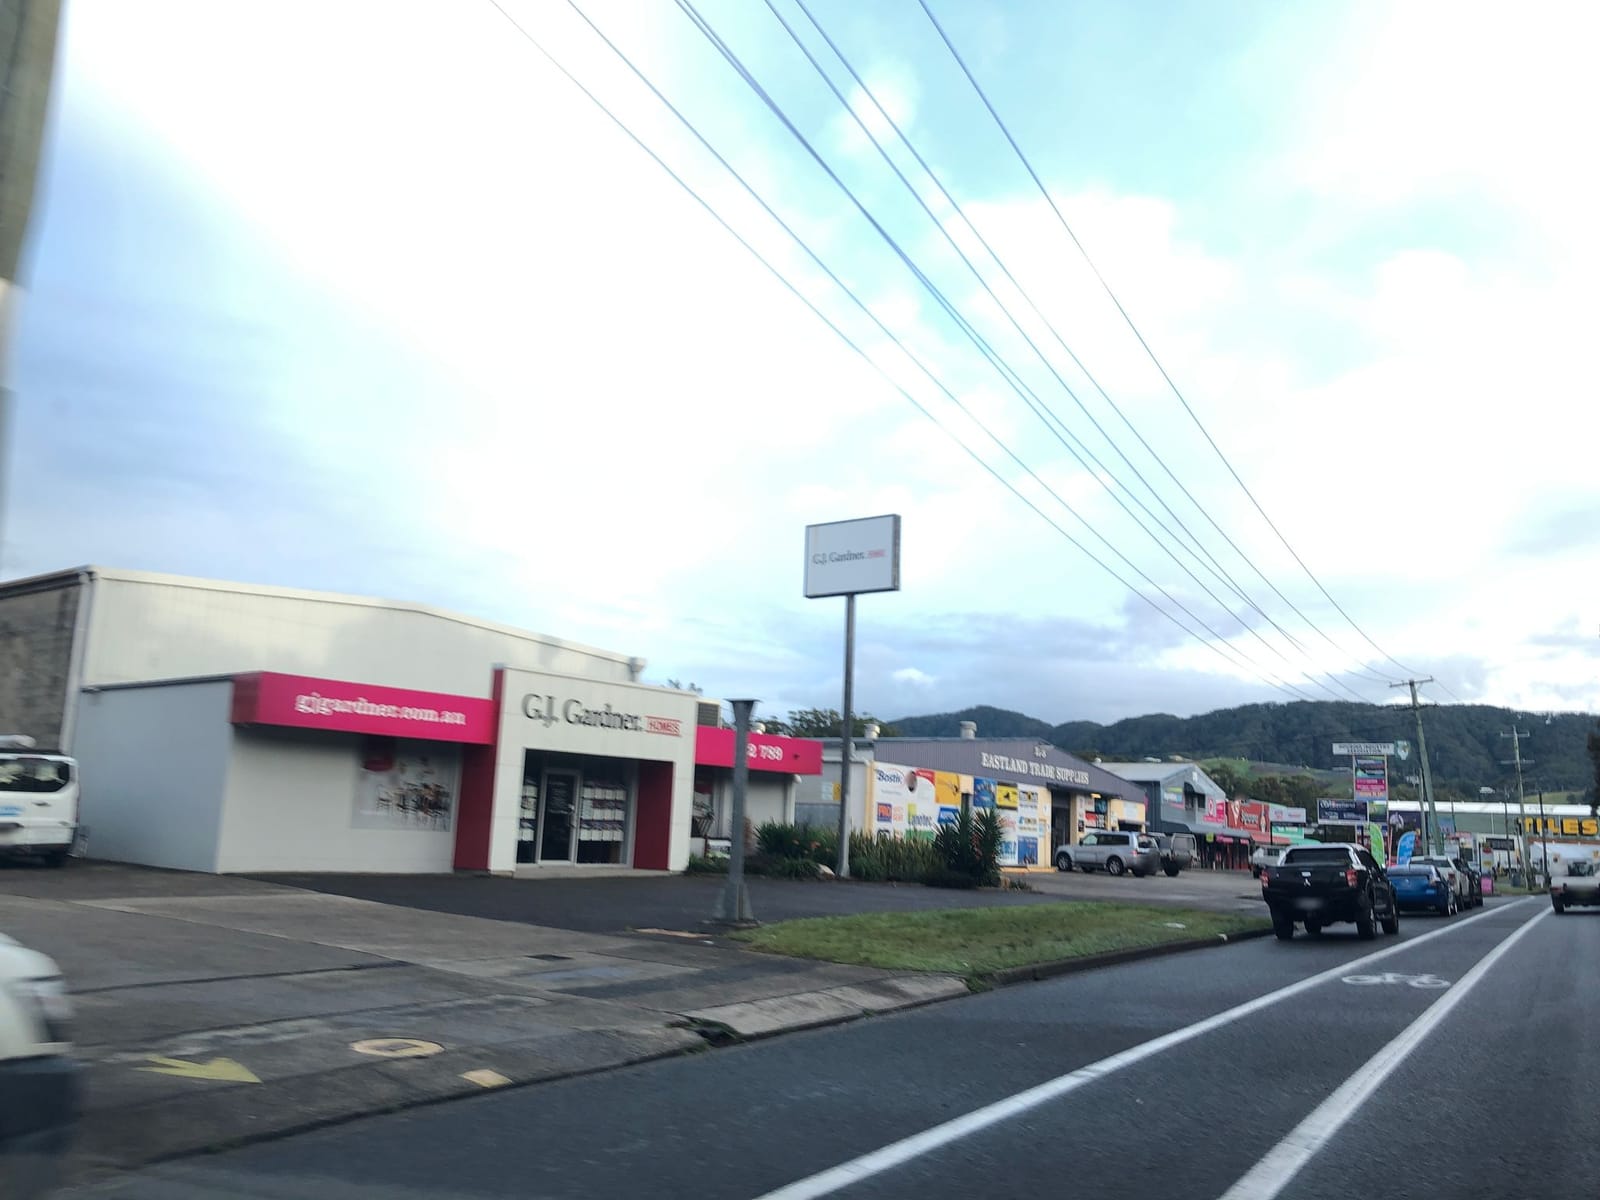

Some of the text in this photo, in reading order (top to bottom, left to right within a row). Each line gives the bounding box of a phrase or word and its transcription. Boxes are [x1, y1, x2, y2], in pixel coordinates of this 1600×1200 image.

[294, 692, 467, 726] gjgardner.com.au
[981, 752, 1090, 785] EASTLAND TRADE SUPPLIES
